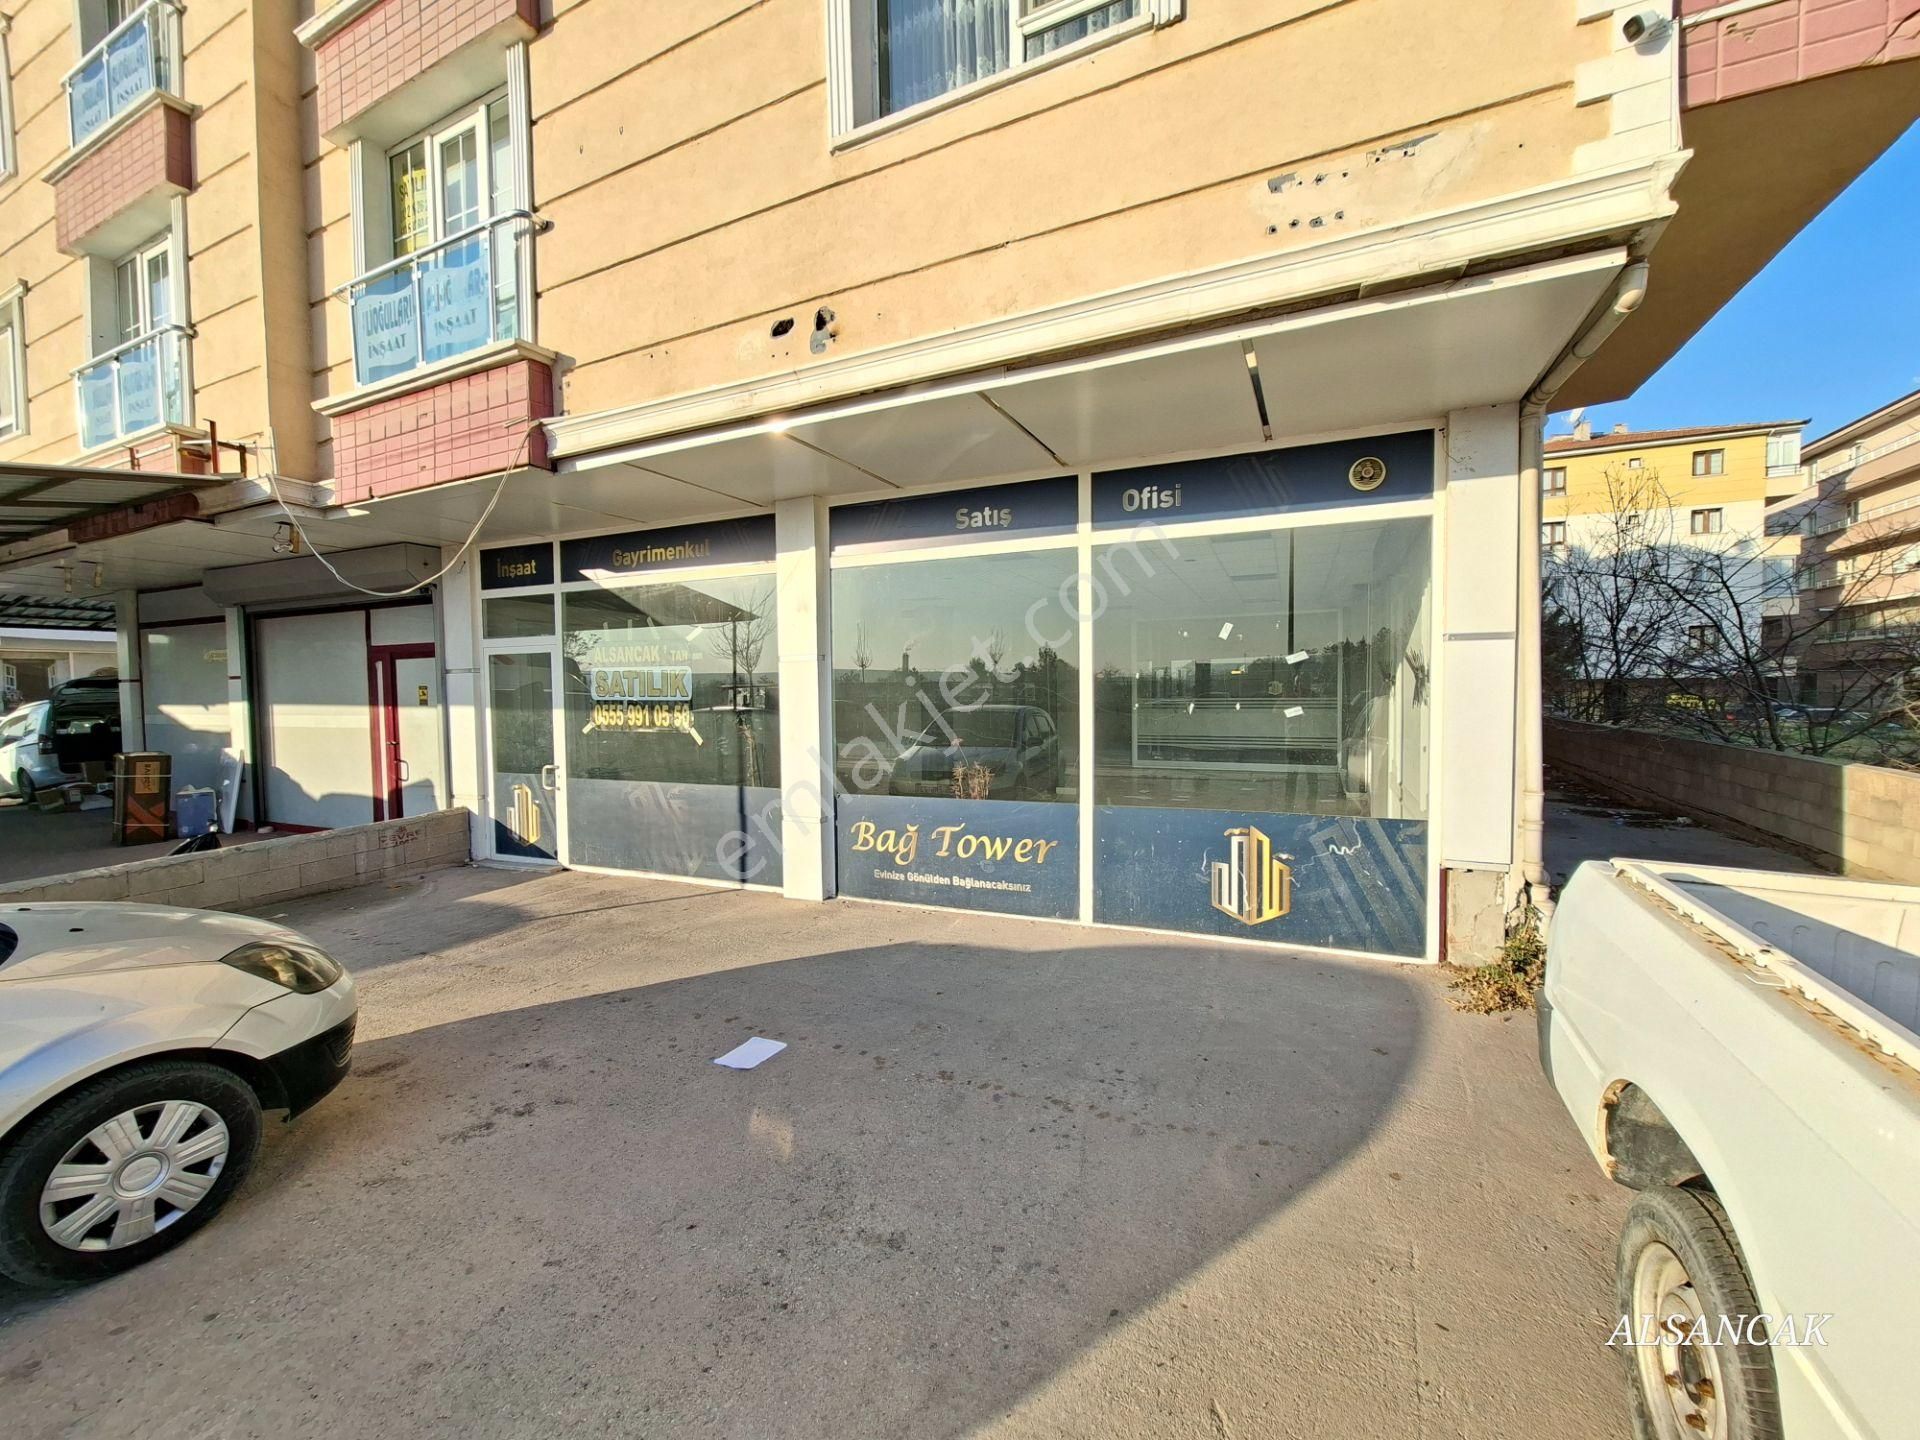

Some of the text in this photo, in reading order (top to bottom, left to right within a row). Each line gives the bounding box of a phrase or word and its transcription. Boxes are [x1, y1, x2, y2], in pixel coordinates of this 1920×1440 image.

[496, 483, 1182, 578] İnşaat Gayrimenkul Satış Ofisi
[594, 669, 689, 697] SATILIK
[594, 704, 624, 726] 0555
[627, 704, 650, 727] 991
[654, 704, 670, 727] 05
[851, 821, 1059, 866] Bağ Tower
[873, 869, 1032, 893] Evinize Gönülden Bağlanacaksınız
